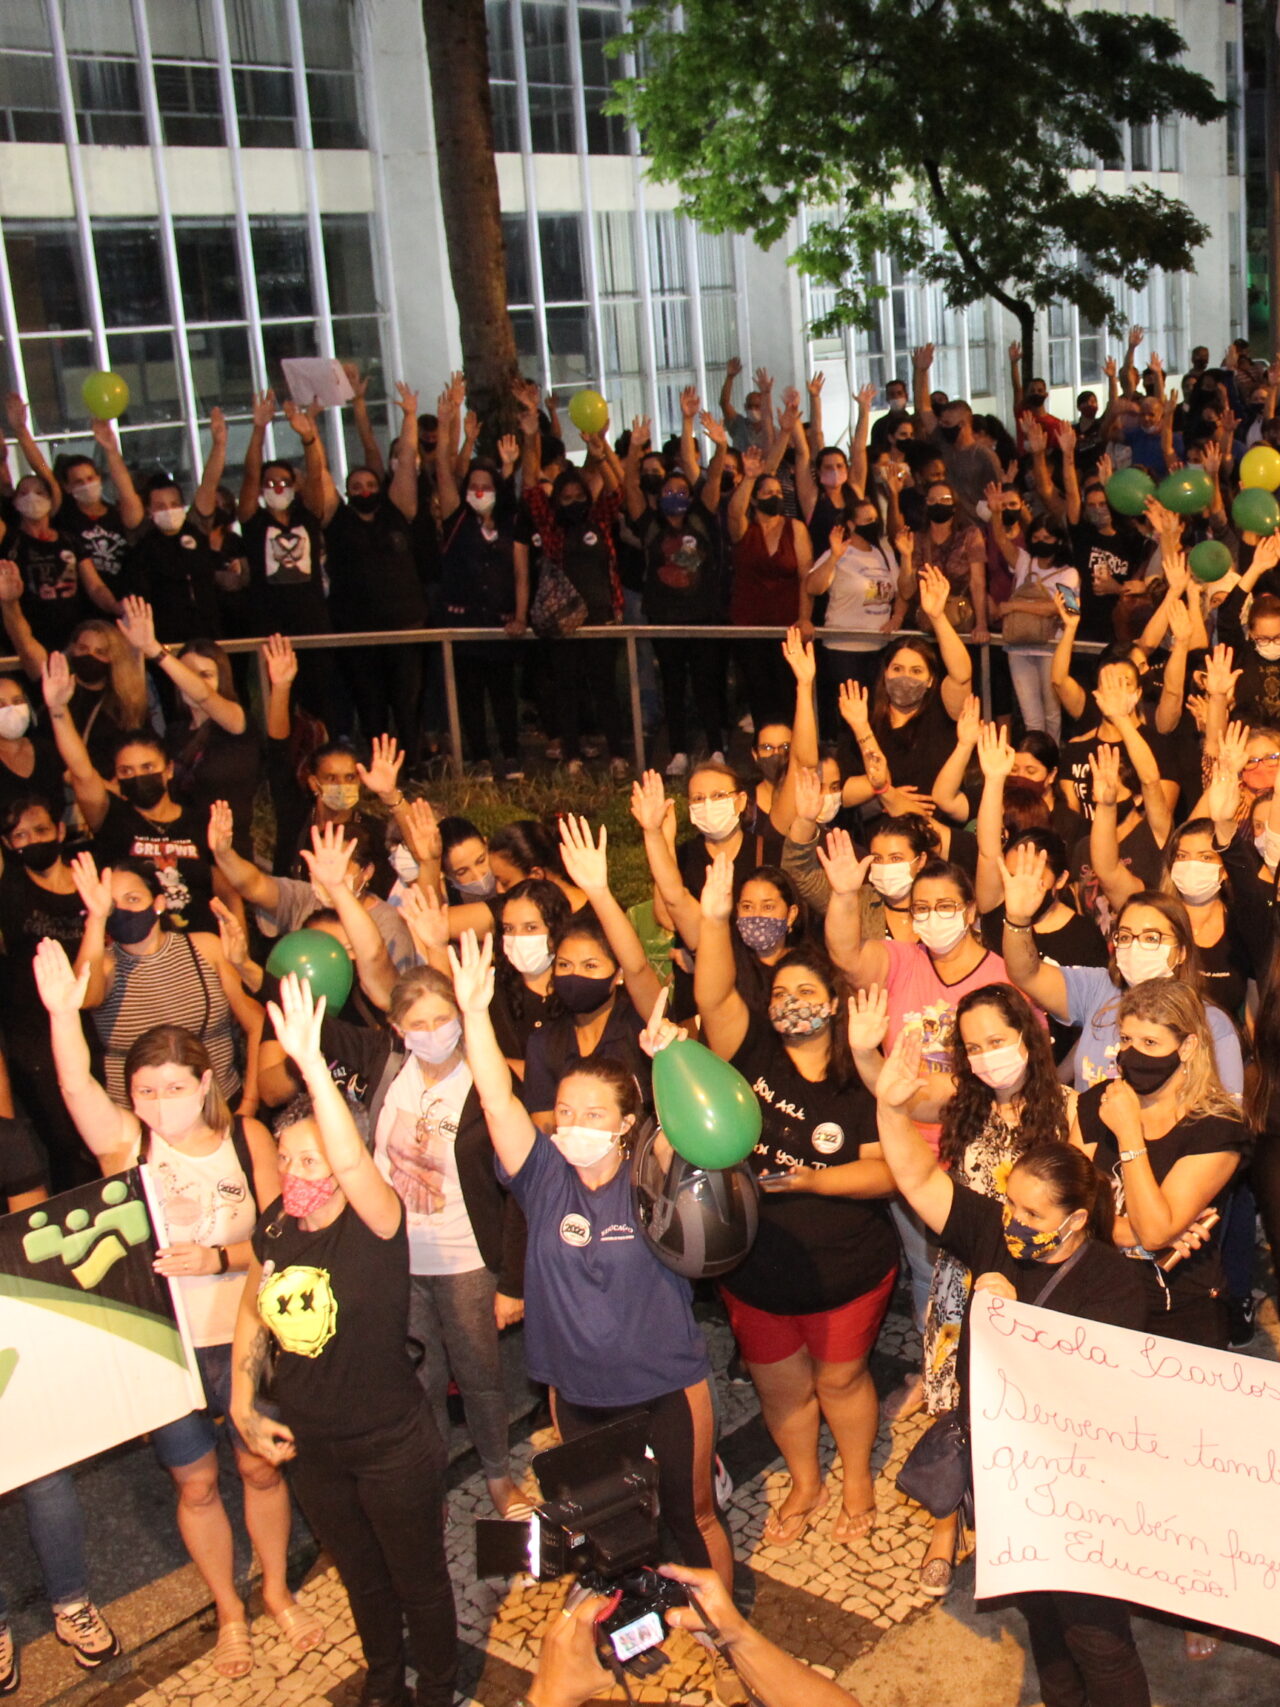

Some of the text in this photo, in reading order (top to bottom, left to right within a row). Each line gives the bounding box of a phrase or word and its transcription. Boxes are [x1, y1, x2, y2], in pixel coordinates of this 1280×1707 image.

[134, 841, 198, 857] GRL PWR
[987, 1297, 1119, 1369] Escola
[1025, 1476, 1209, 1555] Também
[989, 1536, 1050, 1566] da
